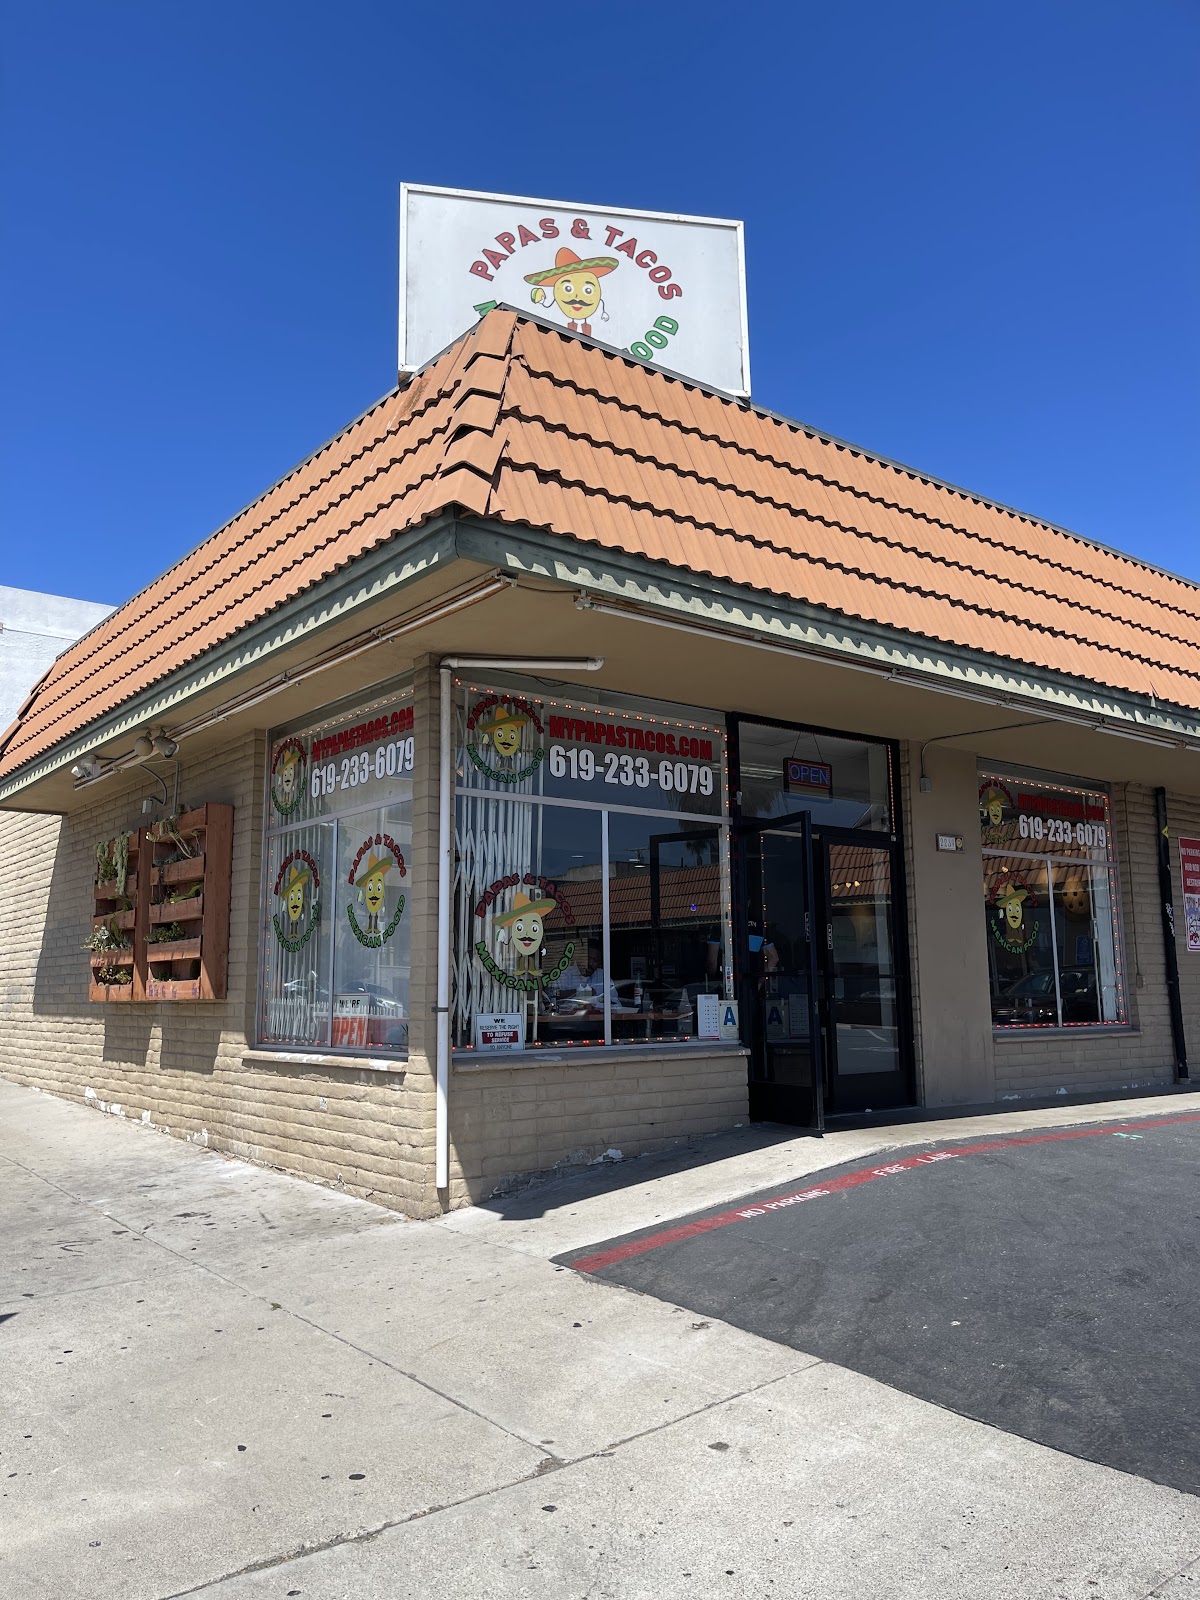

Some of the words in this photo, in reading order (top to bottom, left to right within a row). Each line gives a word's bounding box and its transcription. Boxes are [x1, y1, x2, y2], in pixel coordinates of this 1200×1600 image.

[469, 218, 559, 281] PAPAS
[571, 218, 592, 240] &
[605, 225, 682, 300] TACOS
[621, 315, 679, 360] OOD
[467, 695, 498, 730] PAPAS
[513, 697, 544, 734] TACOS
[549, 715, 712, 761] MYPAPASTACOS.COM
[311, 736, 415, 798] 619-233-6079
[466, 743, 517, 783] MEXICAN
[518, 747, 544, 781] FOOD
[549, 745, 713, 796] 619-233-6079
[790, 764, 829, 785] OPEN
[1019, 814, 1107, 848] 619-233-6079
[348, 836, 373, 885] PAPAS
[383, 833, 406, 878] TACOS
[347, 903, 381, 948] MEXICAN
[383, 895, 405, 944] FOOD
[475, 873, 520, 918] PAPAS
[523, 873, 536, 885] &
[538, 876, 575, 925] TACOS
[990, 917, 1022, 954] MEXICAN
[1023, 921, 1039, 951] FOOD
[475, 941, 539, 991] MEXICAN
[541, 942, 575, 987] FOOD
[723, 1006, 737, 1026] A
[872, 1164, 911, 1177] FIRE
[916, 1152, 959, 1164] LANE
[736, 1204, 765, 1219] NO
[764, 1188, 830, 1210] PARKING
